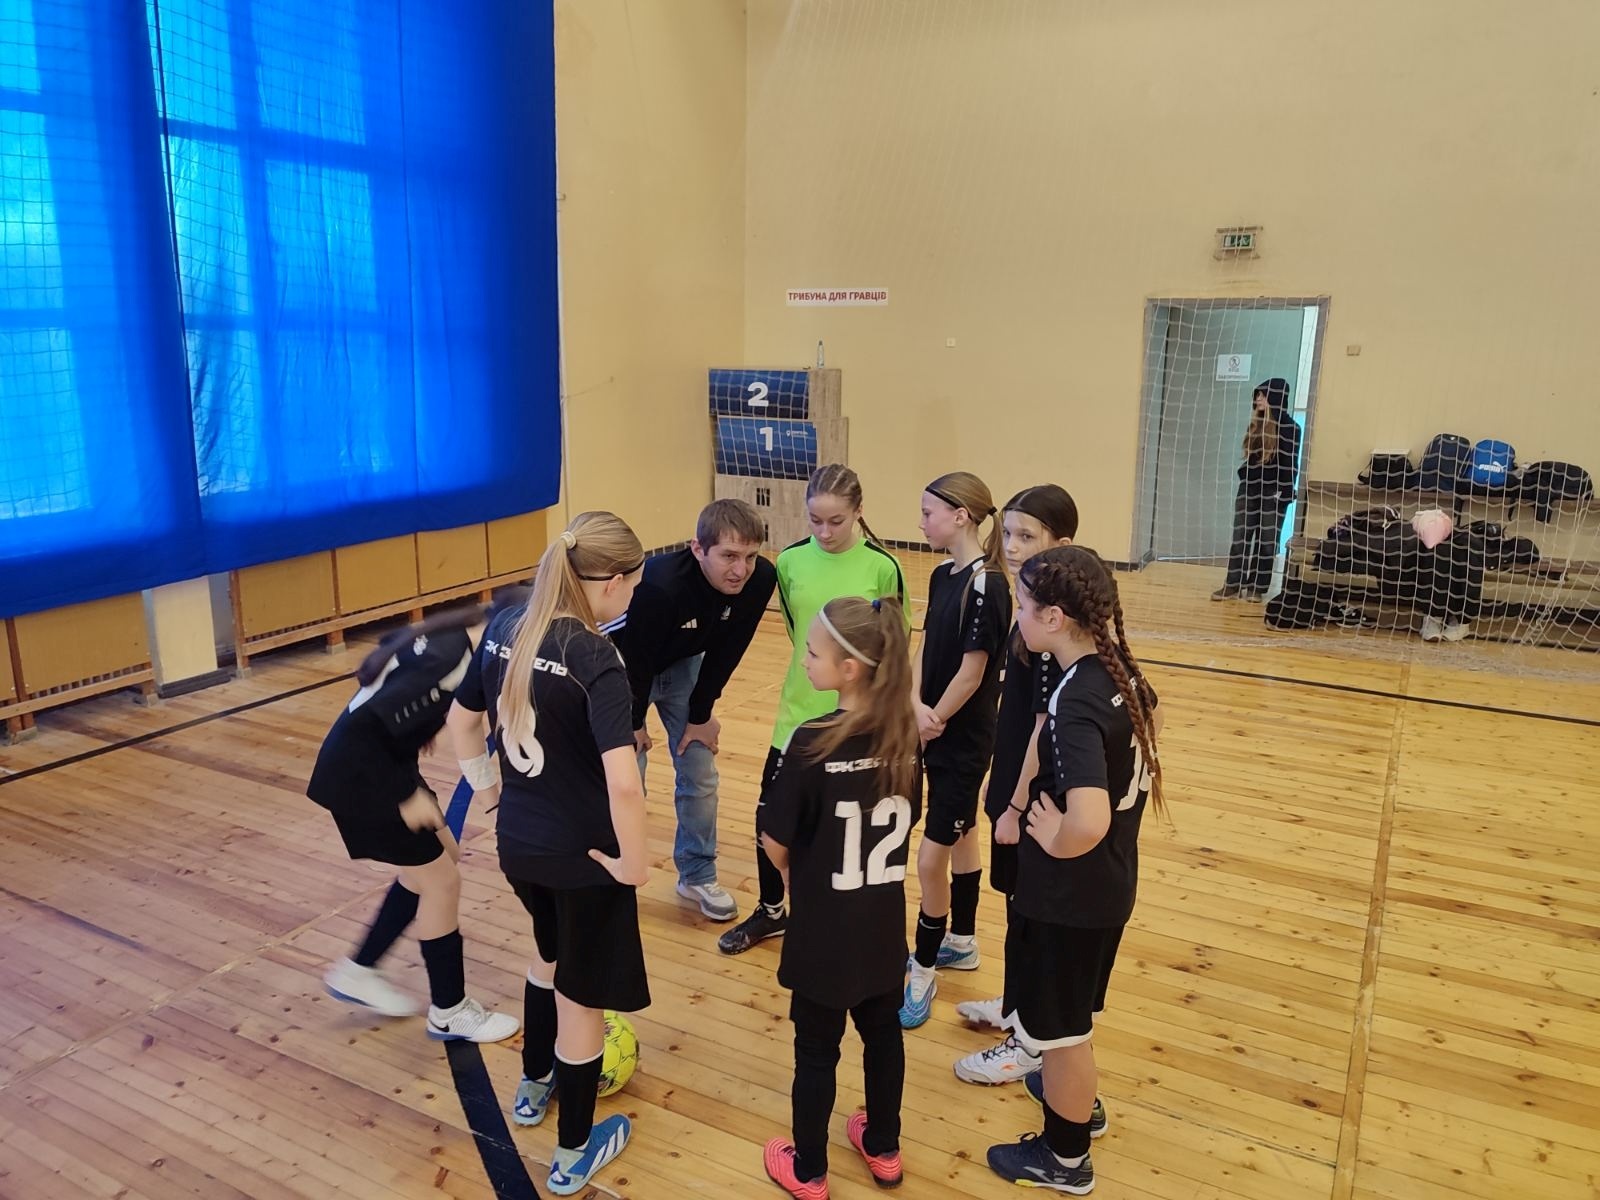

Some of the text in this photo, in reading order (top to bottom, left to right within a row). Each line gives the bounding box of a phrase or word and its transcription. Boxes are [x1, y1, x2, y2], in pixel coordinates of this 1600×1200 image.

[788, 291, 887, 302] ТРИБУНА ДЛЯ ГРАВЦІВ
[747, 381, 769, 407] 2
[759, 426, 773, 451] 1
[831, 794, 912, 891] 12
